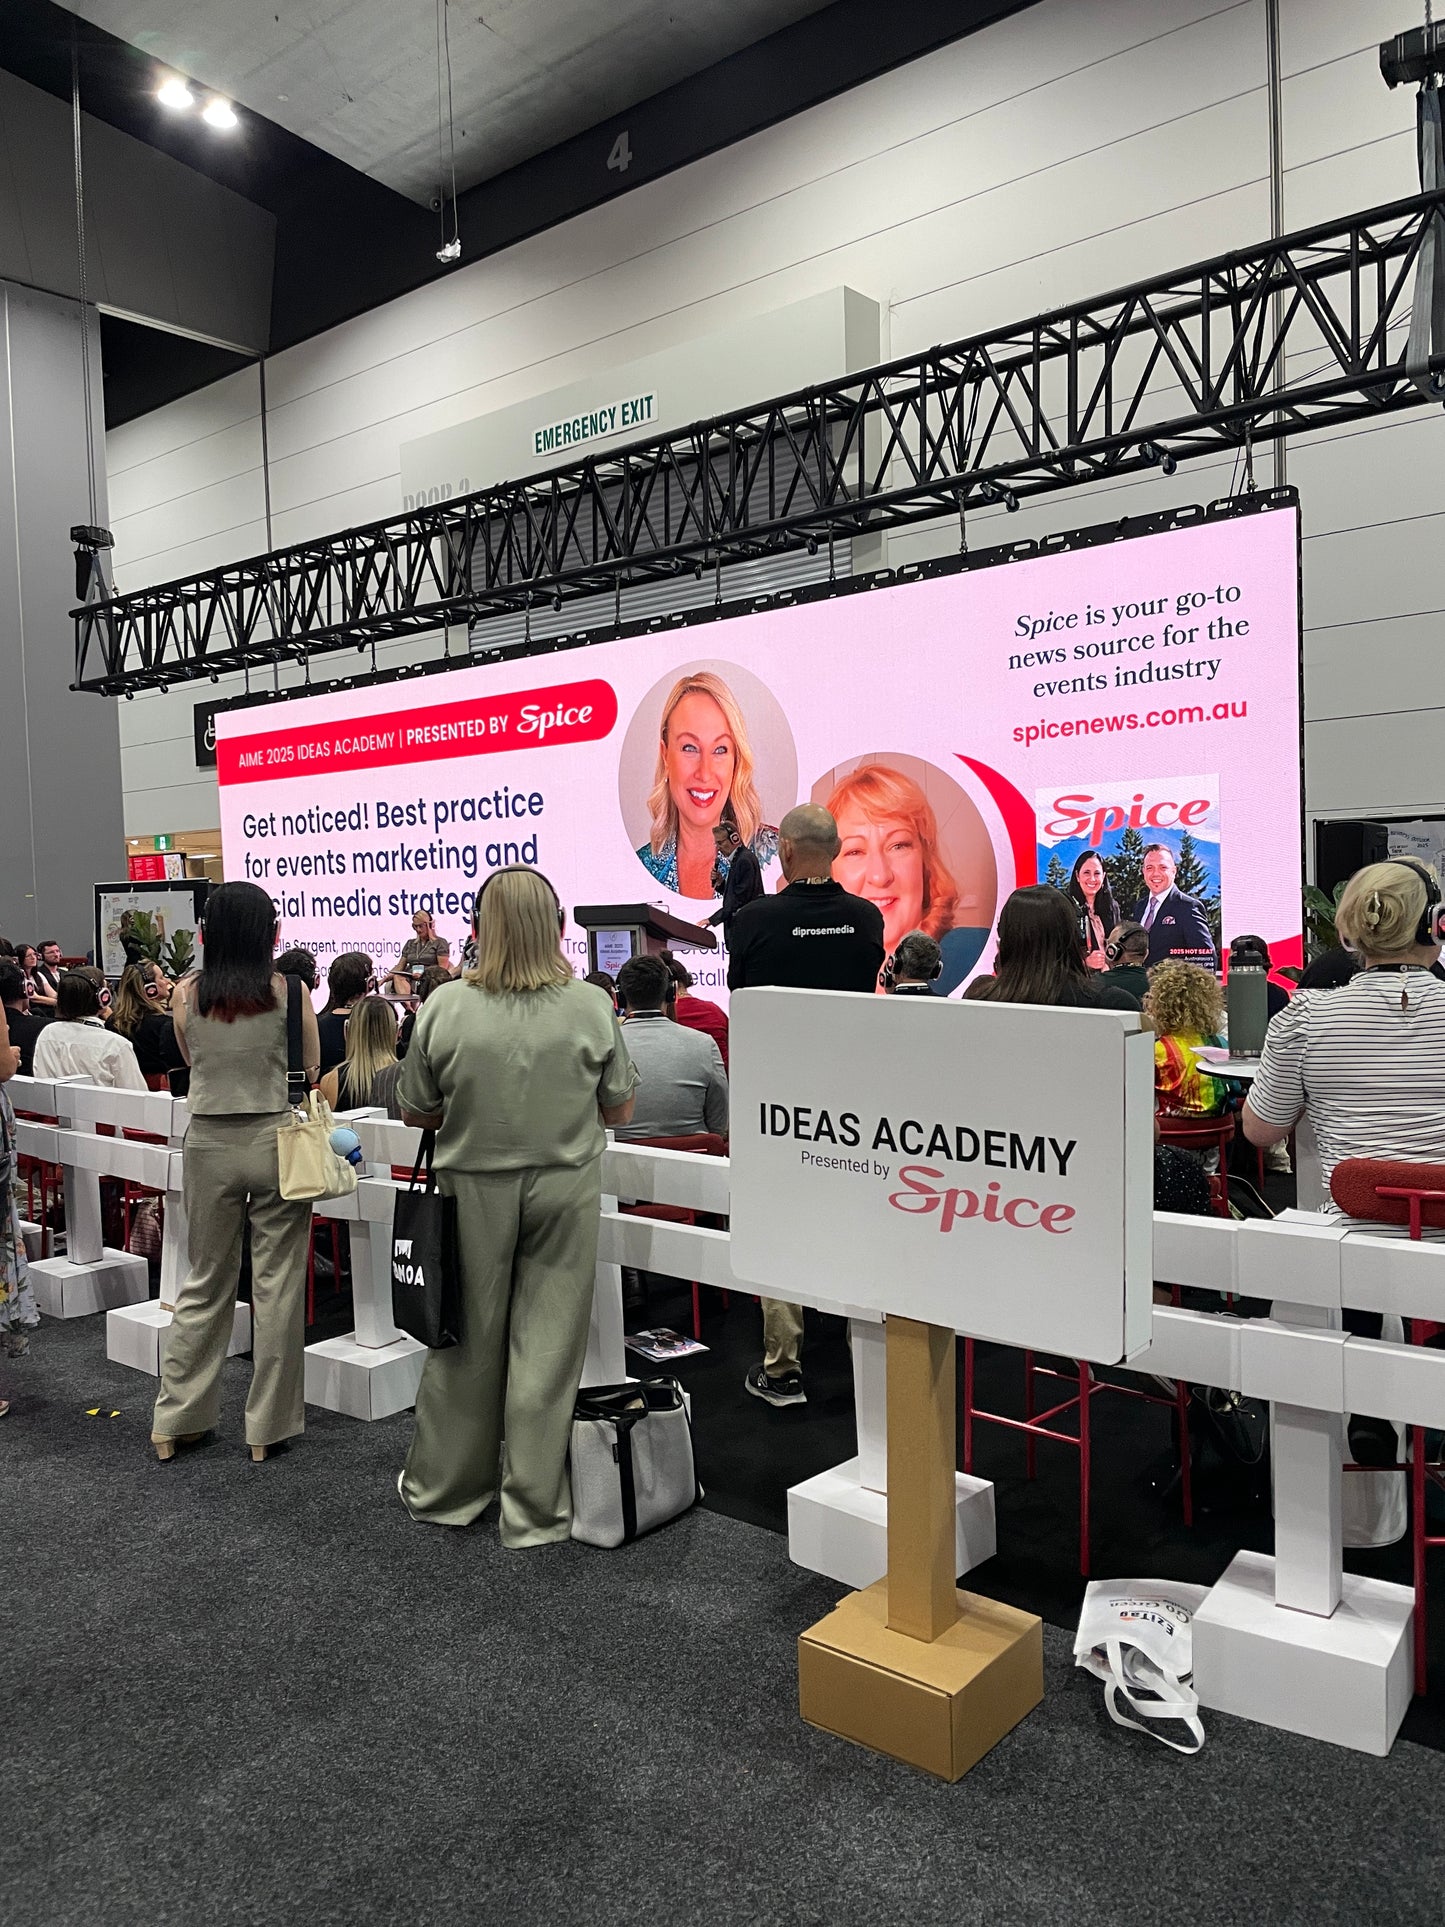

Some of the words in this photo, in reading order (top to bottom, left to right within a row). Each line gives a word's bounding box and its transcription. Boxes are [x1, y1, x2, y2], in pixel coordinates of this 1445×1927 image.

[607, 131, 632, 172] 4
[535, 407, 616, 454] EMERGENCY
[622, 395, 653, 426] EXIT
[1015, 611, 1078, 640] Spice
[1086, 605, 1105, 626] is
[1112, 598, 1168, 626] your
[1176, 584, 1241, 616] go-to
[1009, 647, 1066, 670] news
[1073, 634, 1155, 660] source
[1163, 624, 1199, 648] for
[1207, 616, 1250, 640] the
[1033, 673, 1107, 698] events
[1115, 658, 1222, 688] industry
[239, 750, 264, 768] AIME
[267, 746, 295, 764] 2025
[298, 741, 330, 760] IDEAS
[334, 732, 395, 755] ACADEMY
[406, 719, 485, 746] PRESENTED
[489, 715, 509, 734] BY
[517, 703, 593, 739] Spice
[1013, 701, 1247, 747] spicenews.com.au
[243, 812, 277, 838] Get
[282, 802, 369, 836] noticed!
[376, 798, 427, 828] Best
[434, 786, 544, 834] practice
[1044, 793, 1210, 847] Spice
[245, 852, 271, 878] for
[276, 850, 346, 877] events
[352, 838, 477, 878] marketing
[485, 833, 538, 866] and
[272, 890, 305, 917] cial
[312, 887, 381, 917] media
[388, 888, 476, 924] strateg
[341, 938, 401, 958] managing
[564, 938, 588, 955] Tra
[792, 925, 855, 938] diprosemedia
[604, 960, 622, 971] Spic
[760, 1102, 861, 1147] IDEAS
[871, 1117, 1077, 1176] ACADEMY
[801, 1151, 869, 1174] Presented
[873, 1160, 890, 1180] by
[888, 1165, 1076, 1234] Spice
